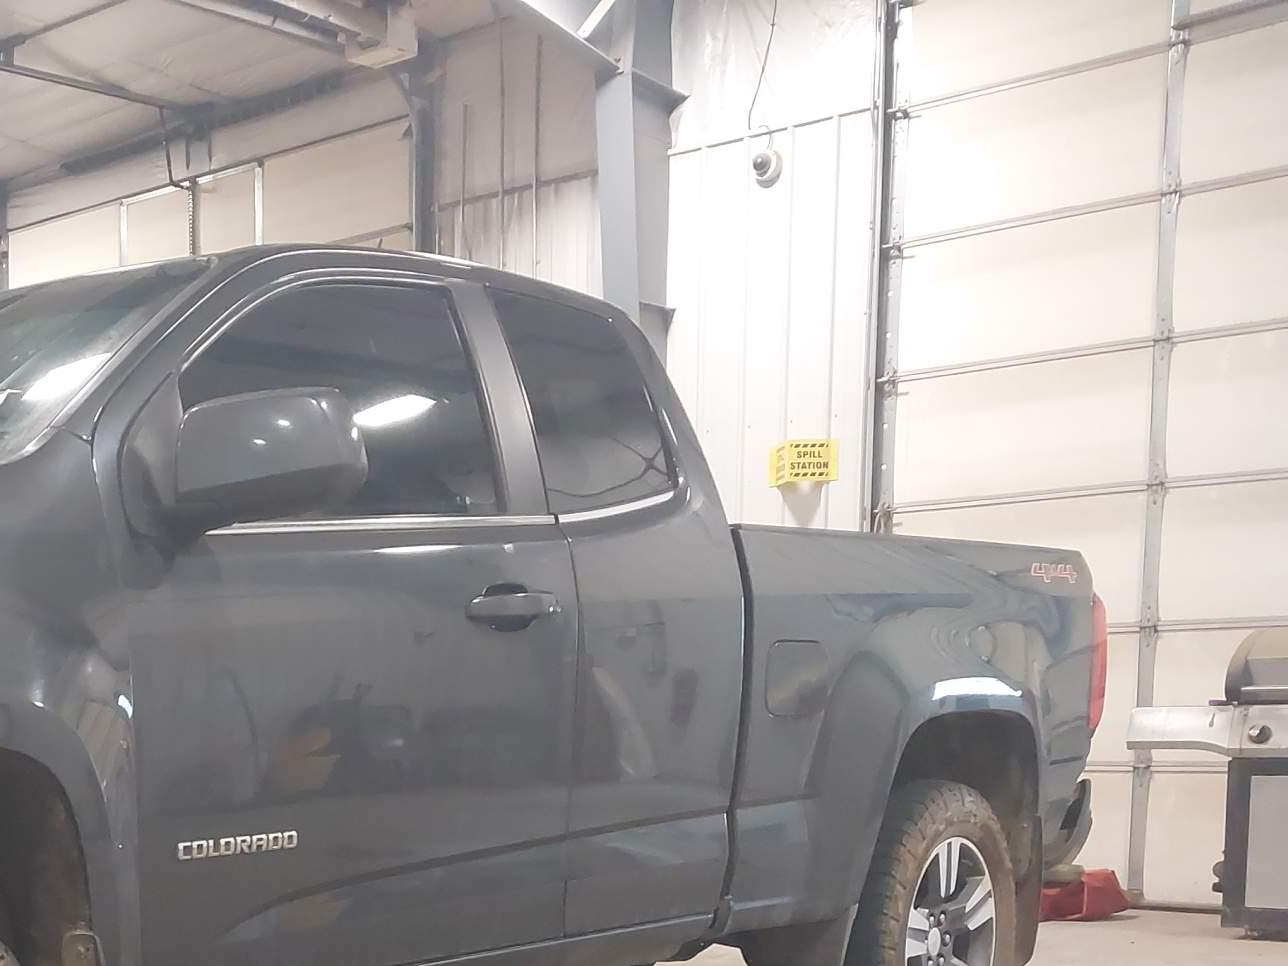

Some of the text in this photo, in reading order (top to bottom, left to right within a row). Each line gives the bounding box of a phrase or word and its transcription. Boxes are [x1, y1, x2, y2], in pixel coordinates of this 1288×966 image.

[796, 450, 824, 459] SPILL
[790, 461, 829, 470] STATION
[177, 830, 298, 861] COLORADO
